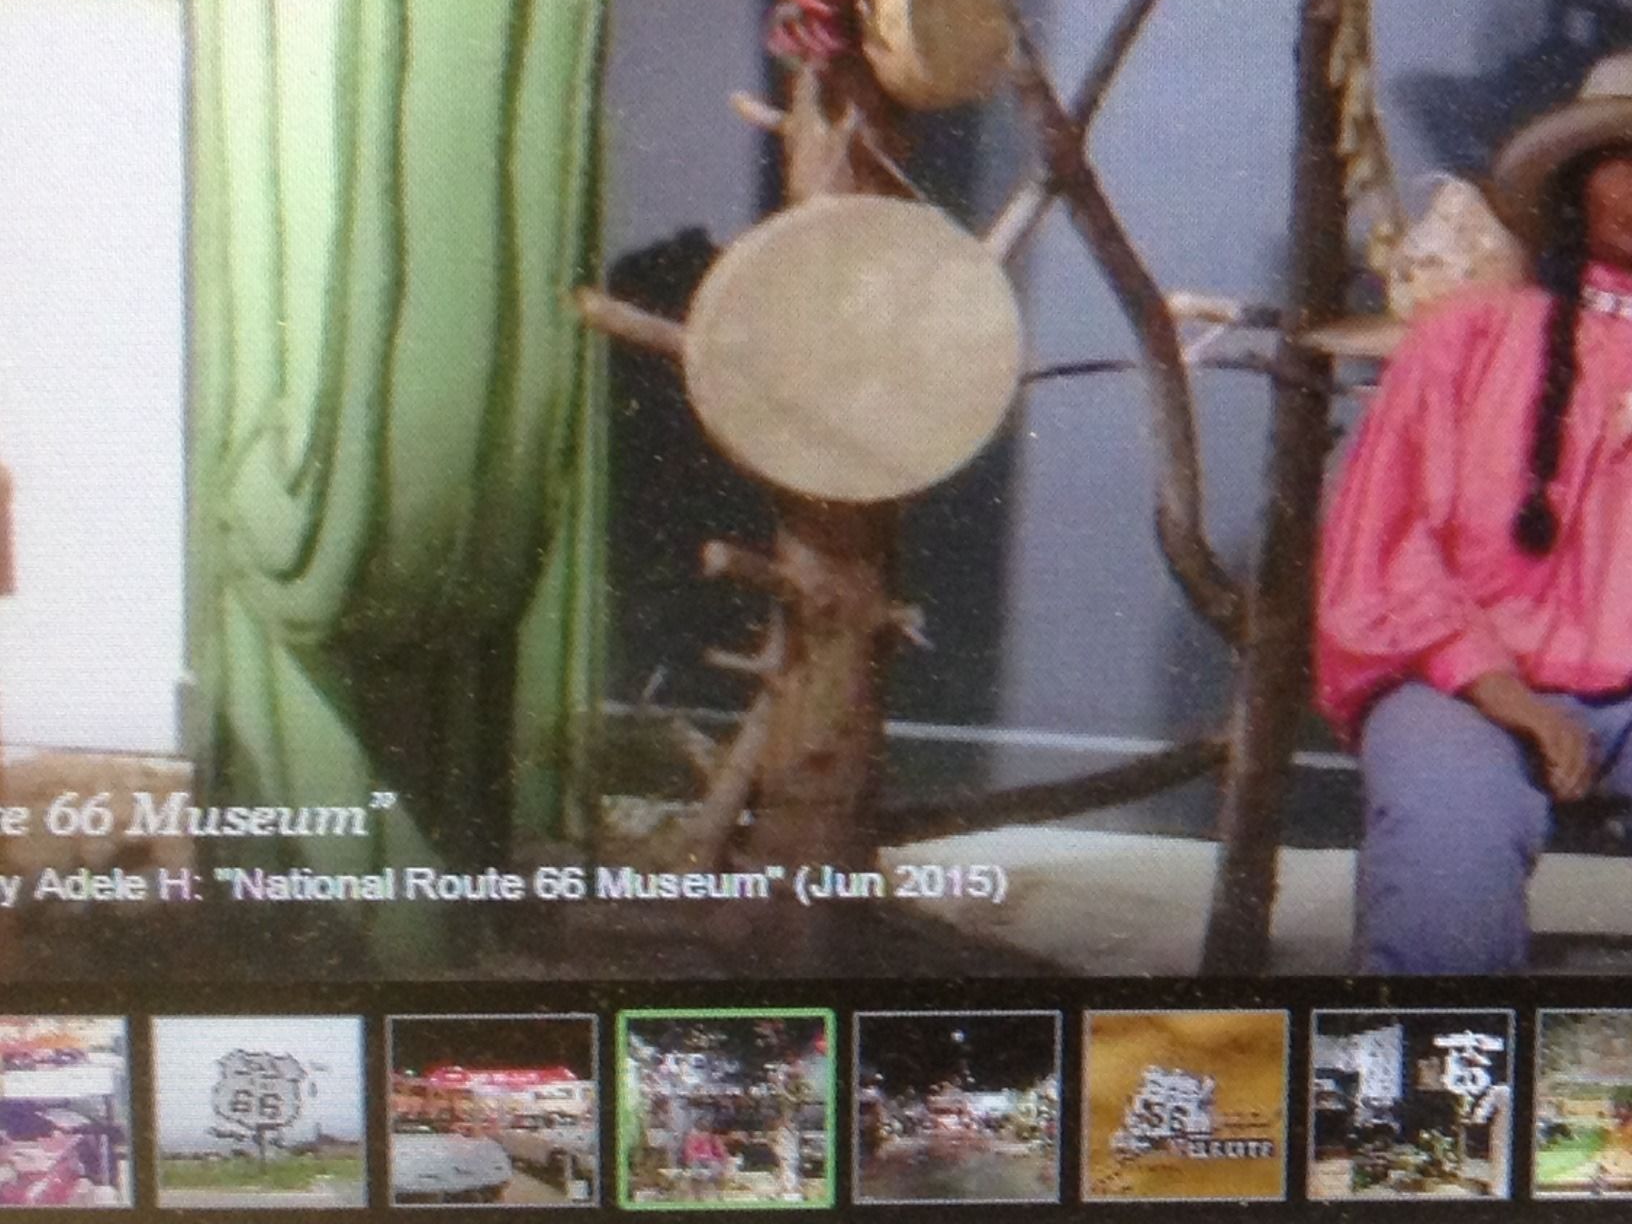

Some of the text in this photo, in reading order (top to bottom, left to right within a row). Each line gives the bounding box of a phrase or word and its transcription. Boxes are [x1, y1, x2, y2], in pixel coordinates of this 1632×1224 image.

[45, 791, 114, 837] 66
[34, 867, 147, 902] Adele
[159, 868, 204, 902] H:
[214, 867, 396, 902] "National
[406, 866, 524, 902] Route
[533, 865, 586, 901] 66
[597, 864, 784, 901] Museum"
[793, 863, 886, 906] (Jun
[895, 862, 1009, 905] 2015)
